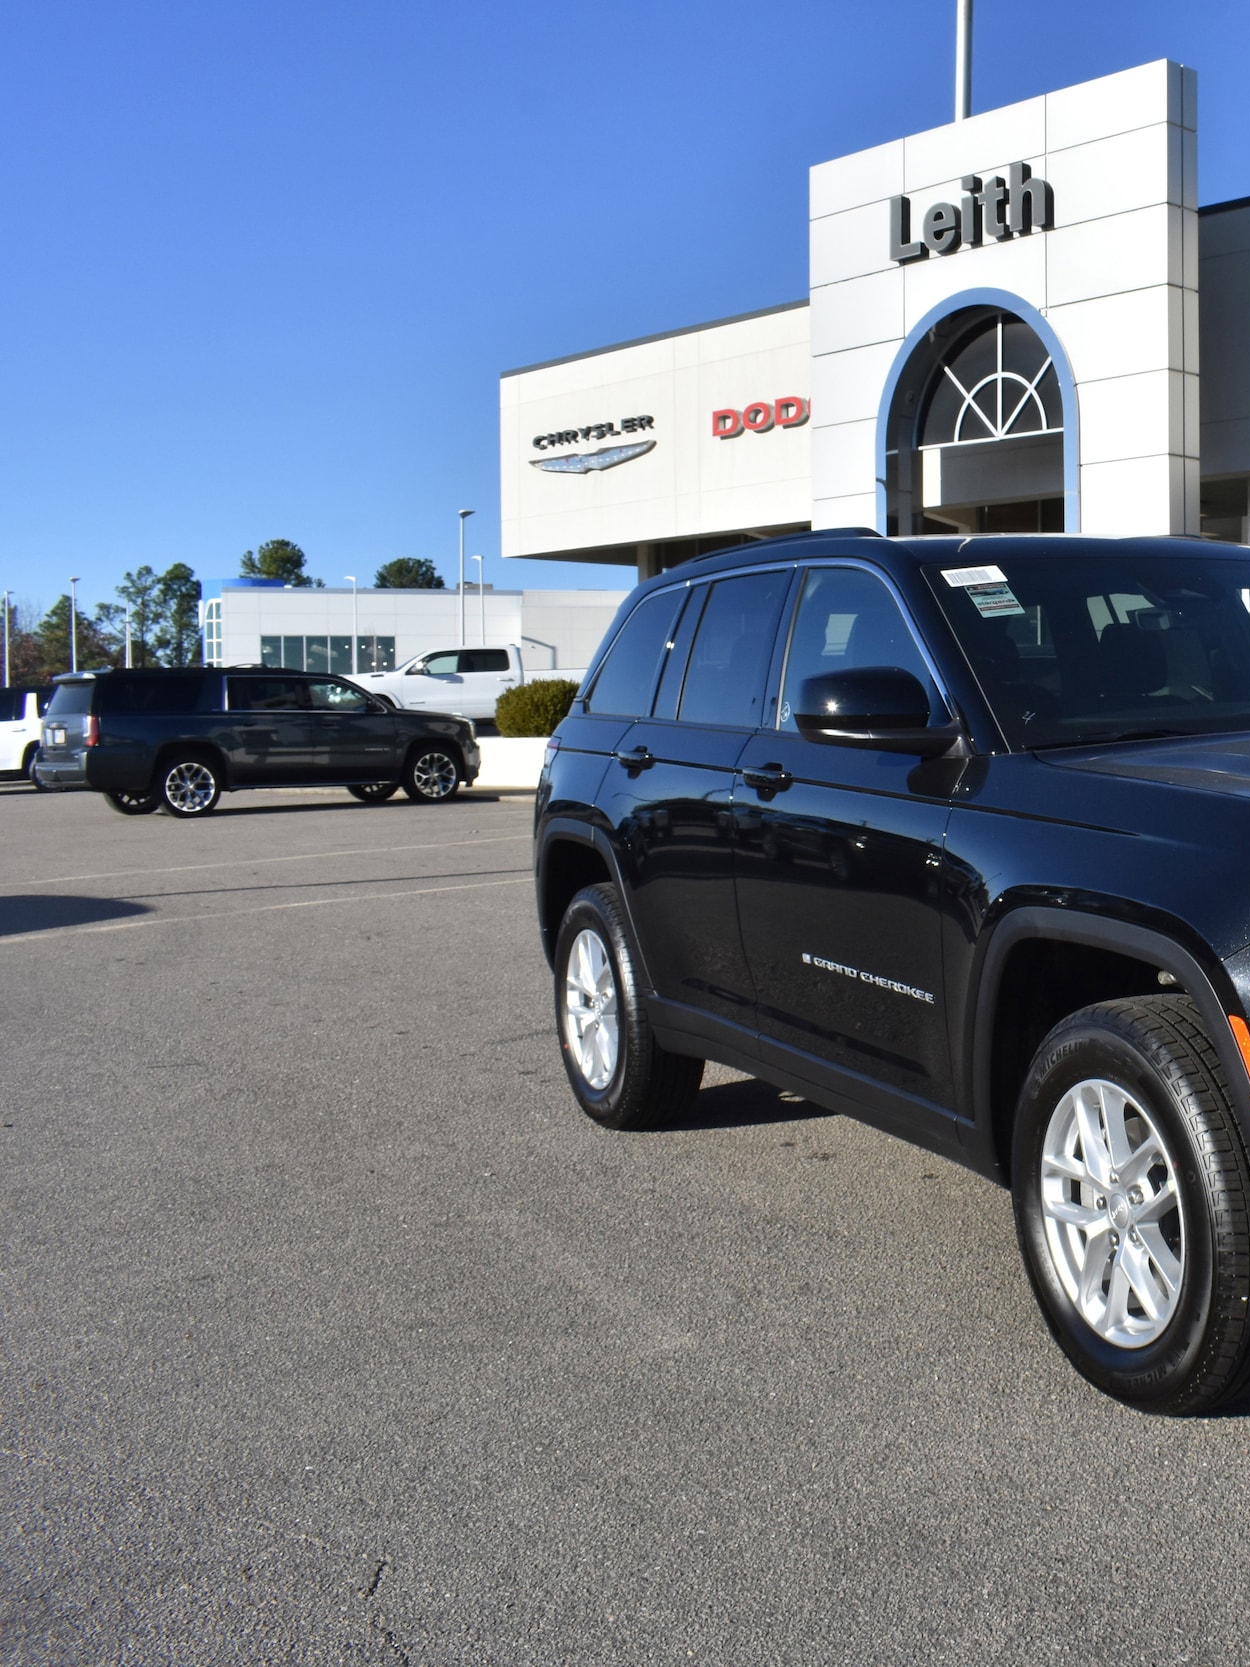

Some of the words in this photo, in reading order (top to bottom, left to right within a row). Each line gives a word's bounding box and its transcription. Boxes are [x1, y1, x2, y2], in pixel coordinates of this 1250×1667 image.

[889, 161, 1055, 266] Leith
[532, 414, 655, 450] CHRYSLER
[712, 396, 810, 440] DOD
[813, 957, 858, 978] GRAND
[860, 972, 935, 1004] CHEROKEE
